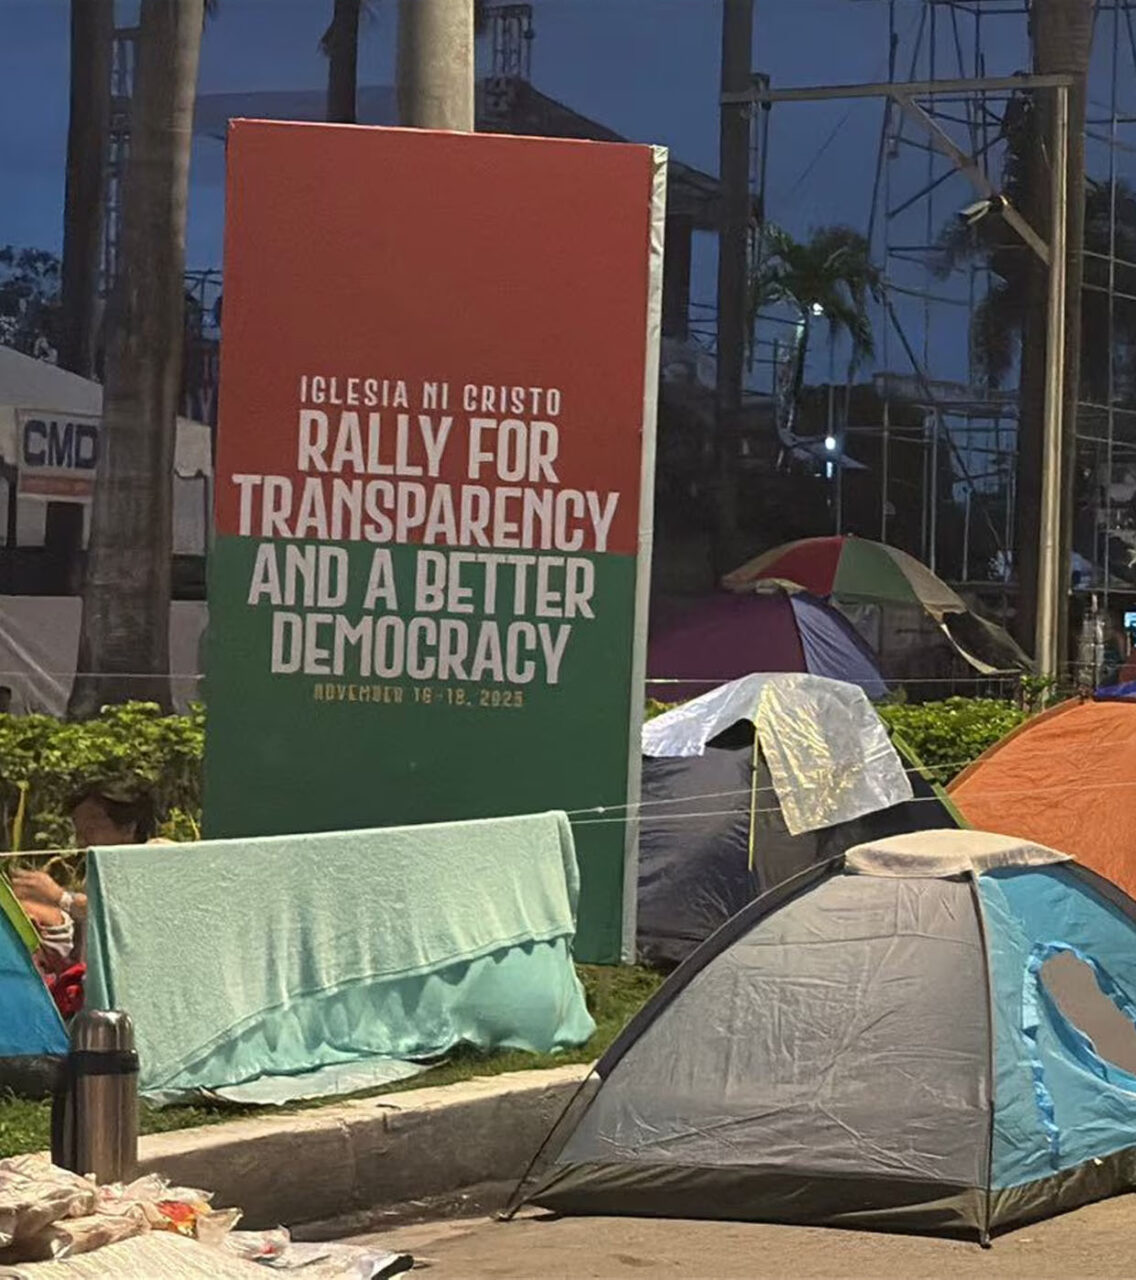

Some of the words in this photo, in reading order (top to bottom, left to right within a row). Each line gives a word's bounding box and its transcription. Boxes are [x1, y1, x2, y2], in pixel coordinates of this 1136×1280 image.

[300, 375, 409, 408] IGLESIA
[422, 381, 448, 410] NI
[463, 383, 561, 416] CRISTO
[297, 409, 454, 478] RALLY
[468, 417, 560, 484] FOR
[232, 473, 621, 553] TRANSPARENCY
[247, 543, 349, 608] AND
[363, 547, 398, 610] A
[414, 550, 596, 619] BETTER
[271, 611, 572, 684] DEMOCRACY
[480, 690, 524, 708] 2025
